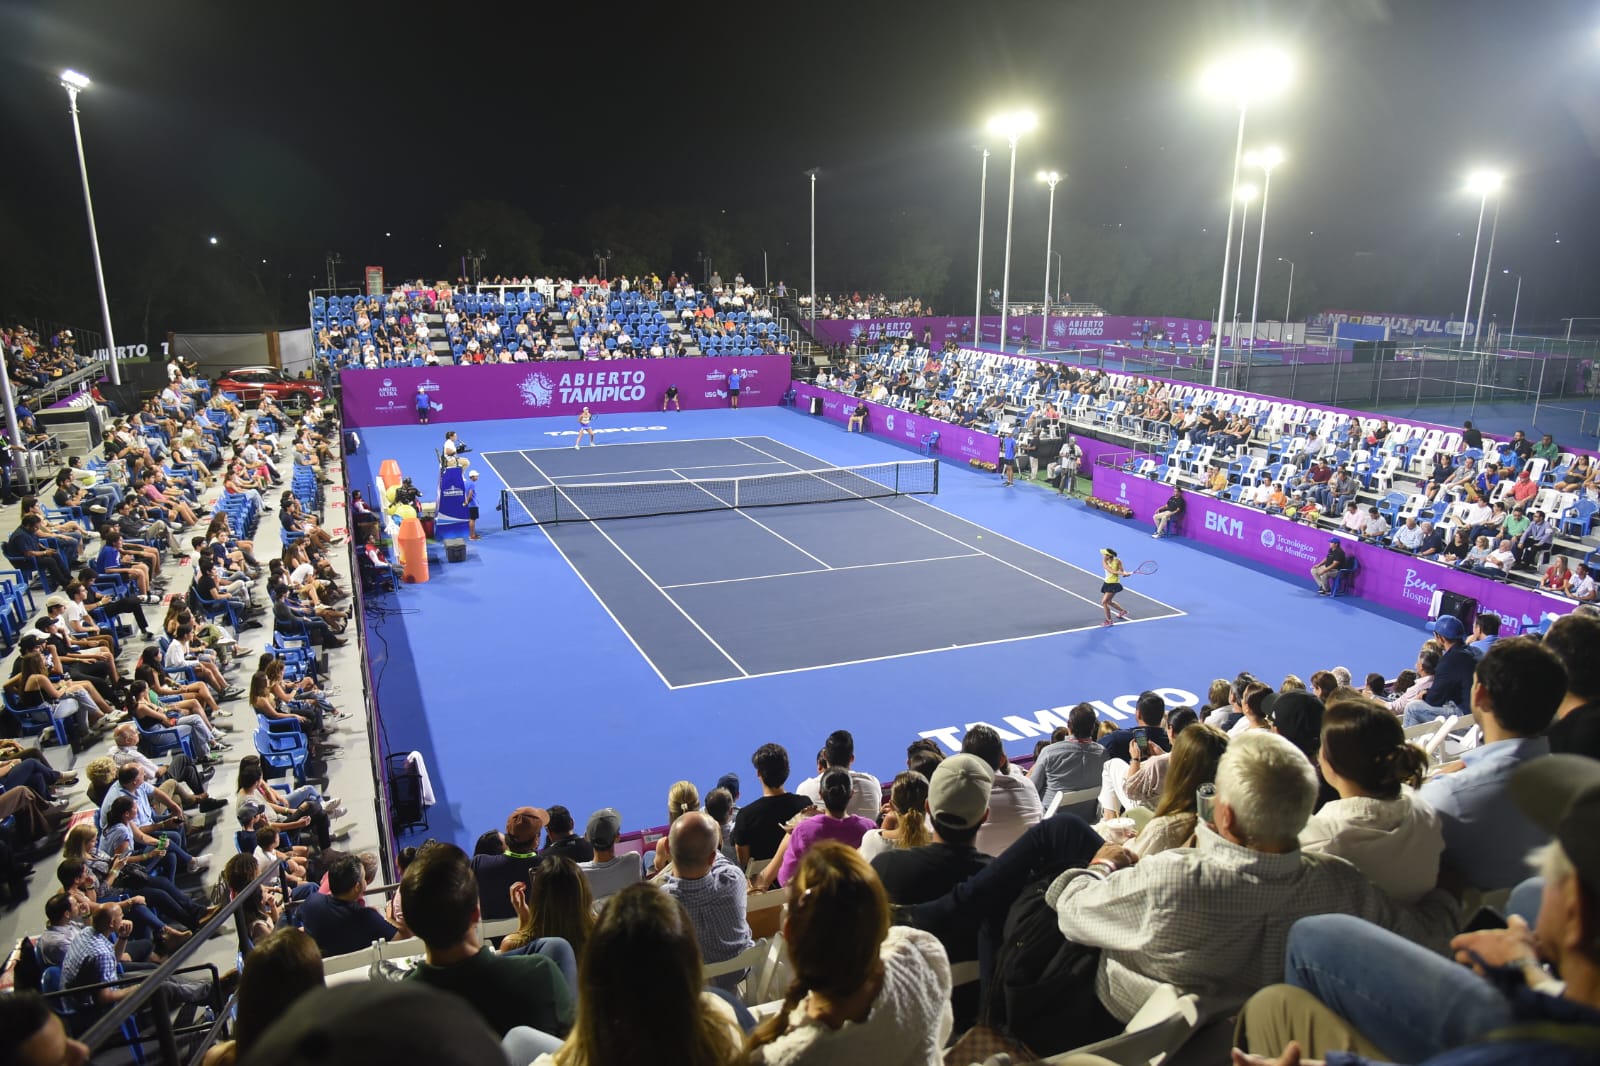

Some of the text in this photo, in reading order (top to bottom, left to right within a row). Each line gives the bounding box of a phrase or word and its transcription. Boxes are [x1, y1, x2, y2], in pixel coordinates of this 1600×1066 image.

[1068, 327, 1104, 336] TAMPICO
[559, 370, 646, 387] ABIERTO
[559, 384, 646, 404] TAMPICO
[1205, 510, 1243, 540] BKM
[1277, 534, 1314, 553] Tecnológico
[1275, 543, 1318, 564] de Monterrey
